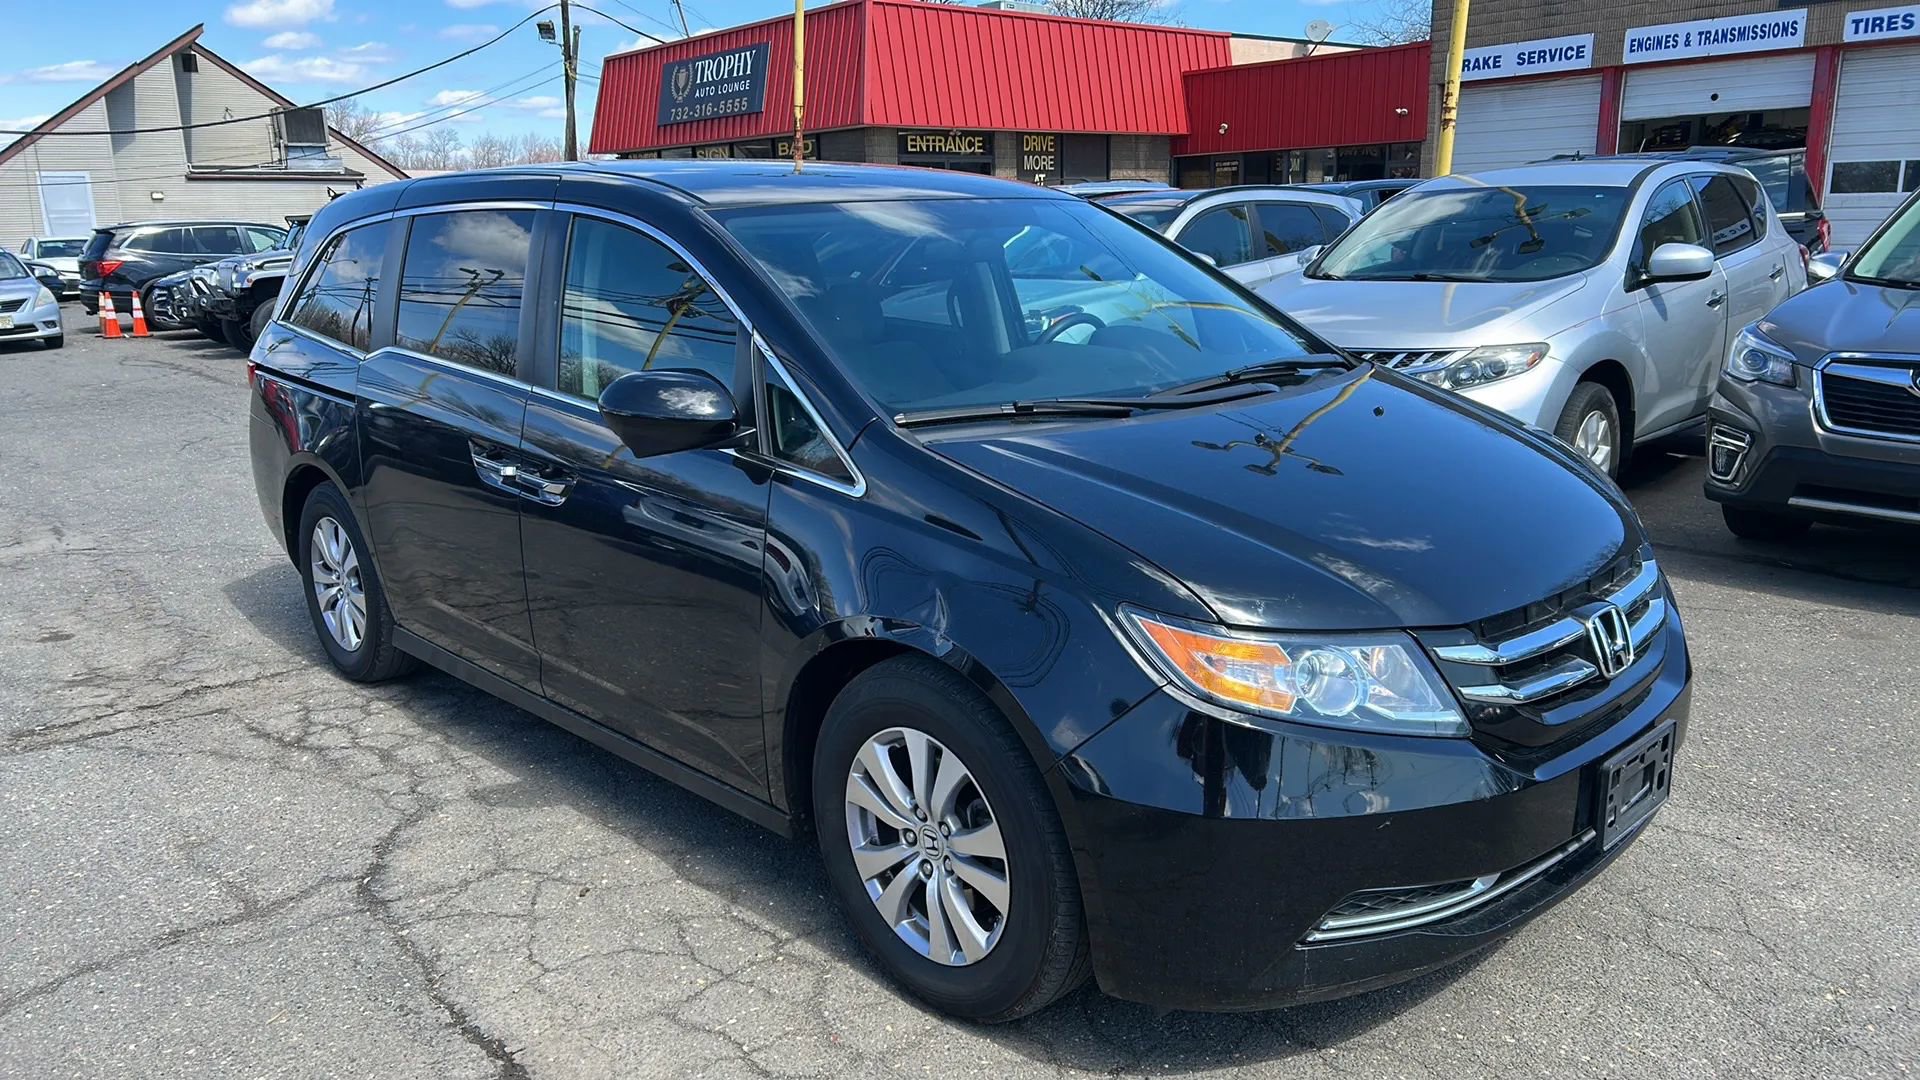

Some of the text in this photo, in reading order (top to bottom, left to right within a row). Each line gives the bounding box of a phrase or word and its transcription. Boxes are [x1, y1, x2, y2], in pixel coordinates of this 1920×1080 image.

[1851, 13, 1915, 35] TIRES
[1629, 20, 1798, 53] ENGINES & TRANSMISSIONS
[695, 50, 756, 84] TROPHY
[1462, 44, 1586, 72] RAKE SERVICE
[695, 80, 751, 98] AUTO LOUNGE
[670, 97, 748, 121] 732-316-5555
[696, 146, 729, 159] SIGN
[907, 135, 983, 153] ENTRANCE
[1024, 135, 1055, 151] DRIVE
[1024, 155, 1055, 170] MORE
